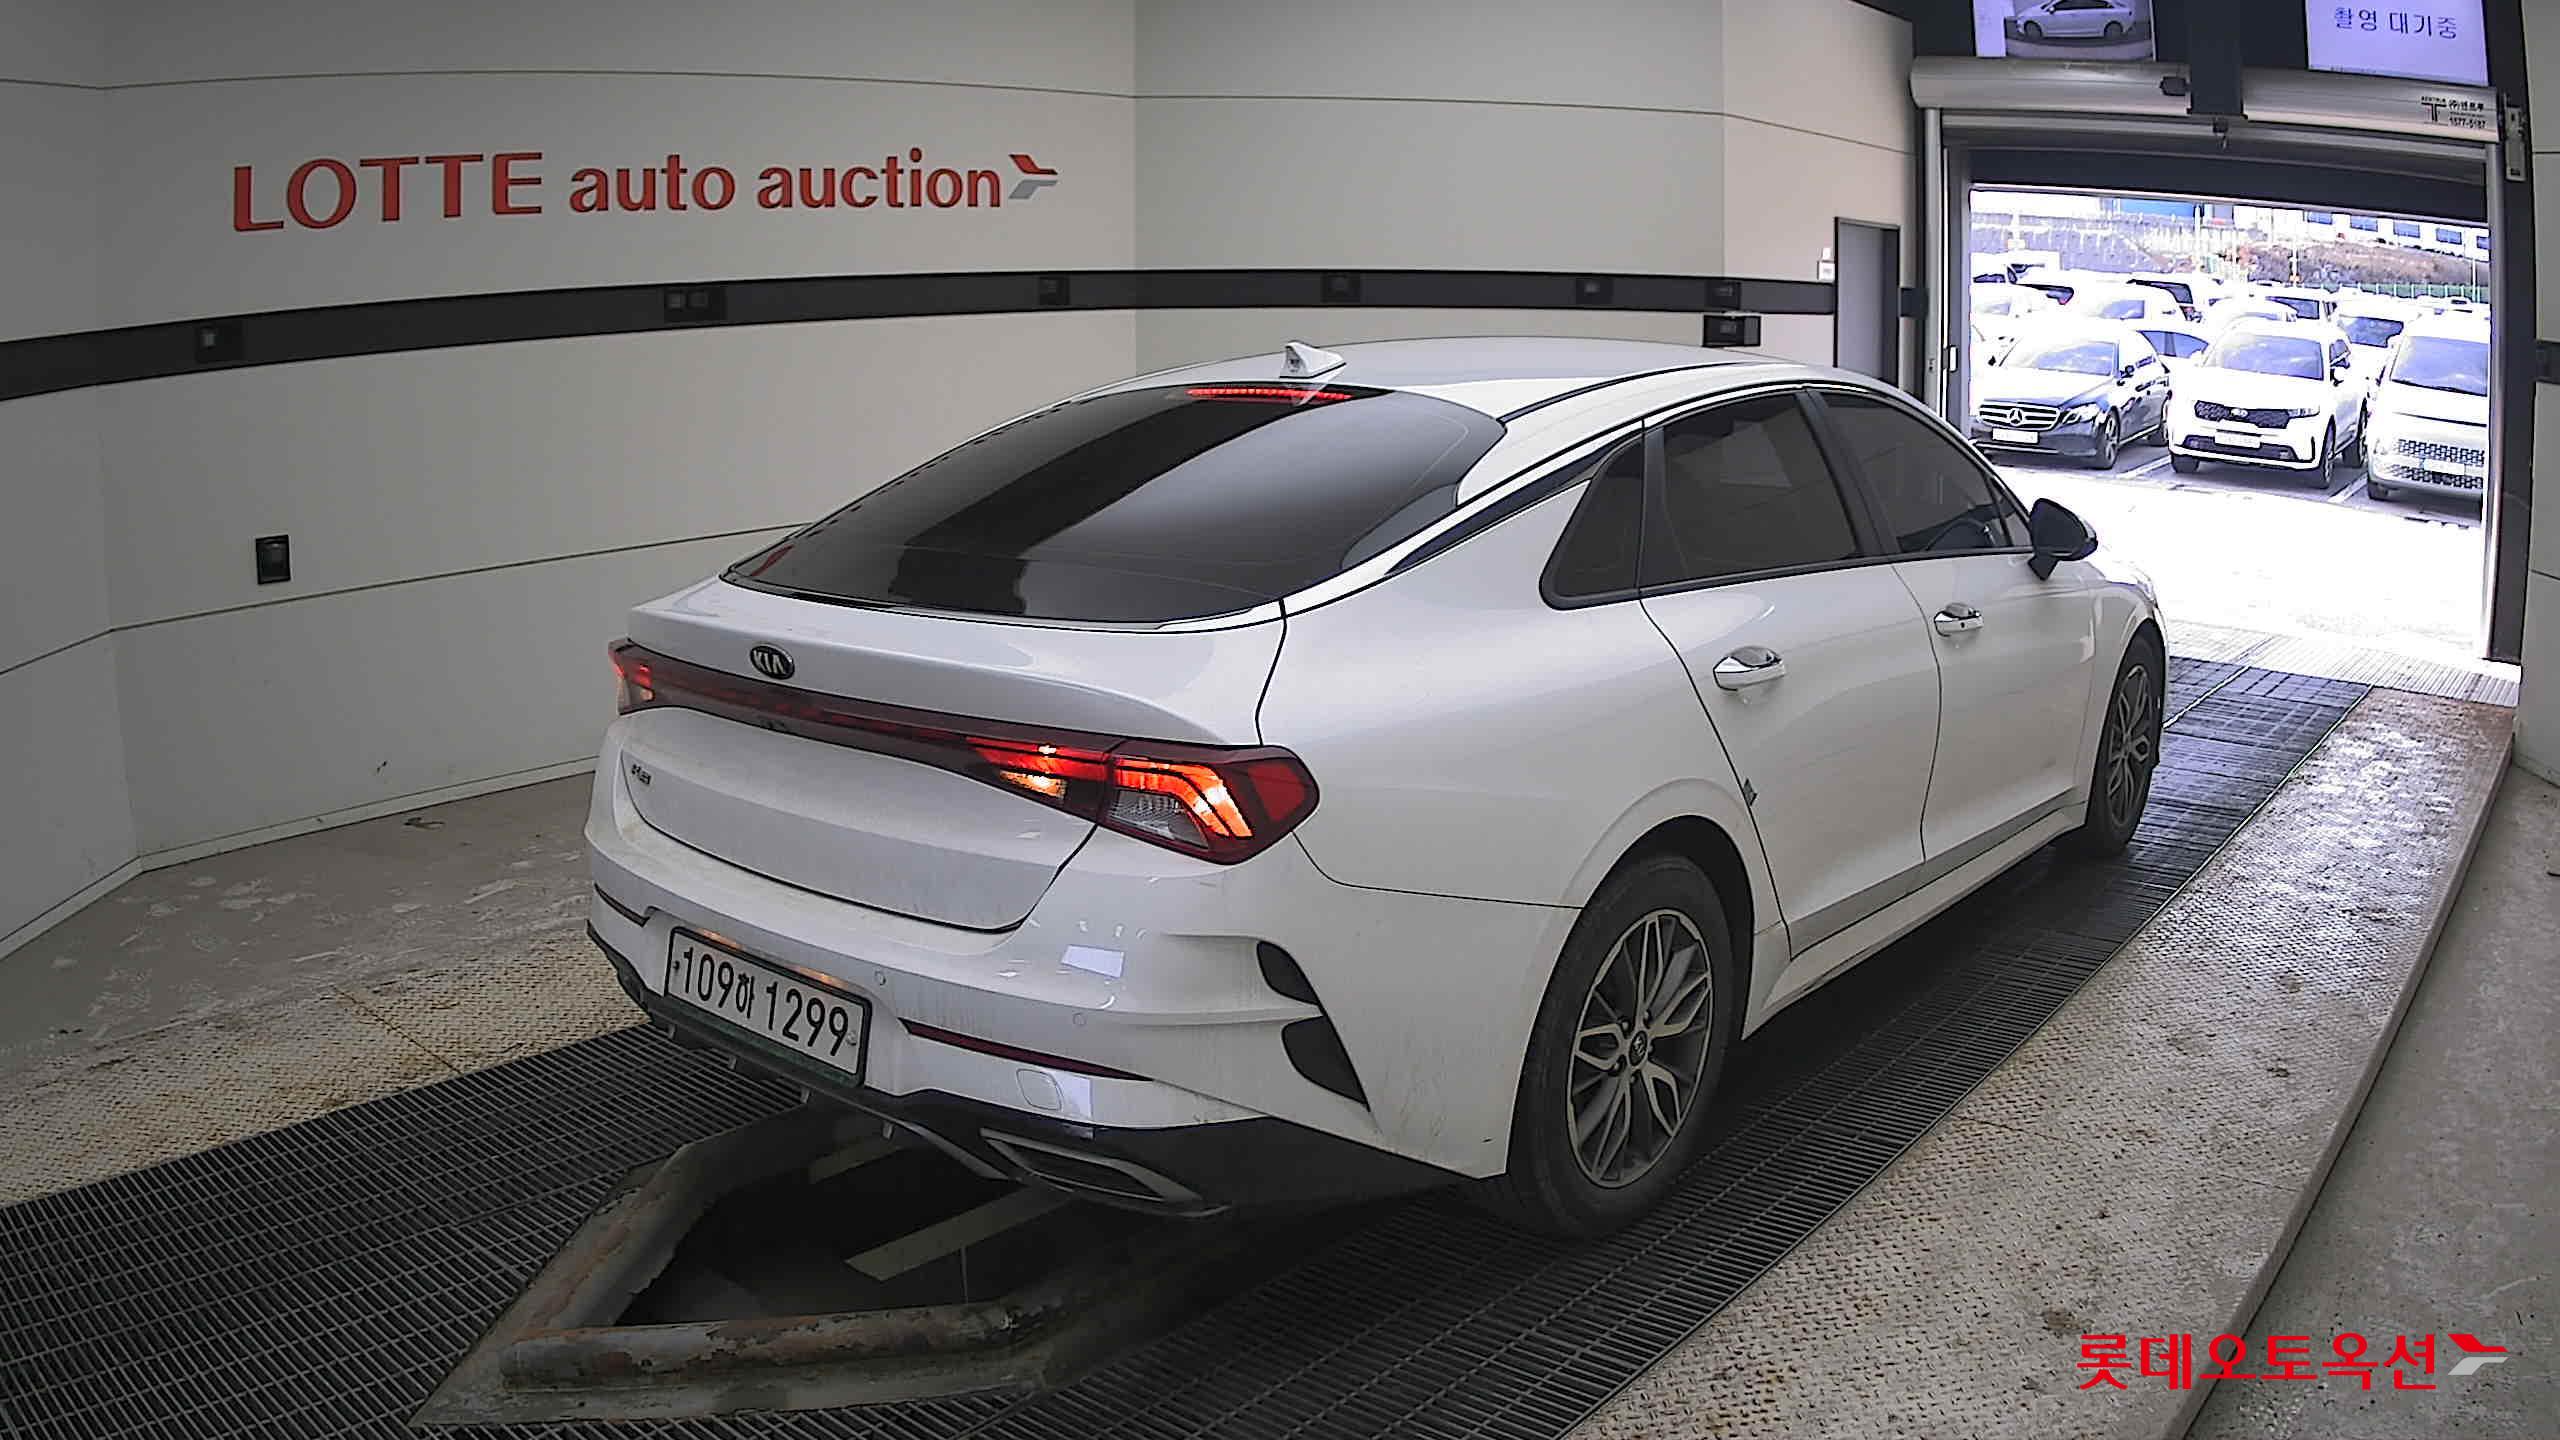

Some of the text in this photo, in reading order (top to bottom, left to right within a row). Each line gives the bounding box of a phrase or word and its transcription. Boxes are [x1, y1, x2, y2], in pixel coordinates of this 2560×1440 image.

[2334, 7, 2457, 40] 촬영 대기중
[233, 148, 1001, 232] LOTTE auto auction
[752, 648, 786, 675] KIA
[683, 946, 849, 1057] 109하 1299
